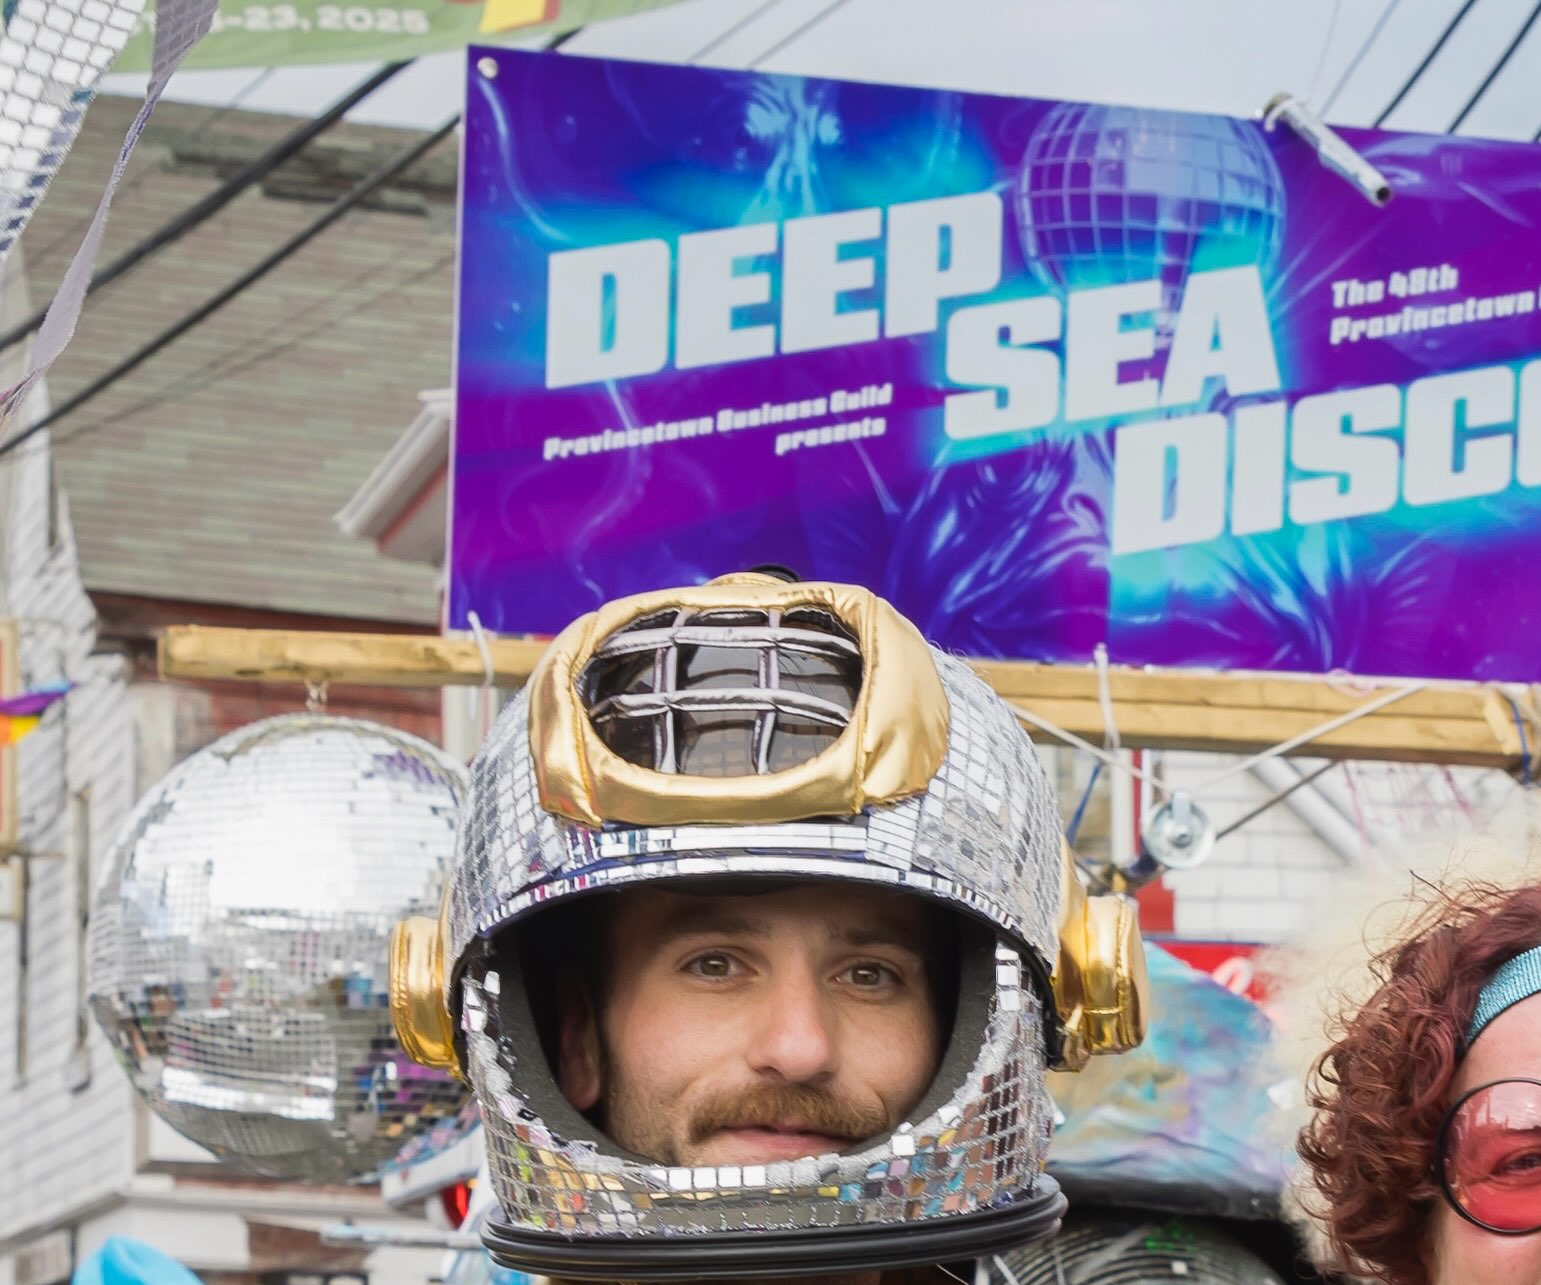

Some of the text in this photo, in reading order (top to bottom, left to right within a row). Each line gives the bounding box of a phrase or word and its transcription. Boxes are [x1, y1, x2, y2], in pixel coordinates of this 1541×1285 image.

[316, 5, 430, 33] 2025
[545, 190, 1004, 390] DEEP
[1329, 290, 1535, 345] Provincetown
[1332, 279, 1385, 309] The
[943, 264, 1283, 441] SEA
[543, 382, 893, 461] Provincetown Business Guild
[775, 417, 886, 457] presents
